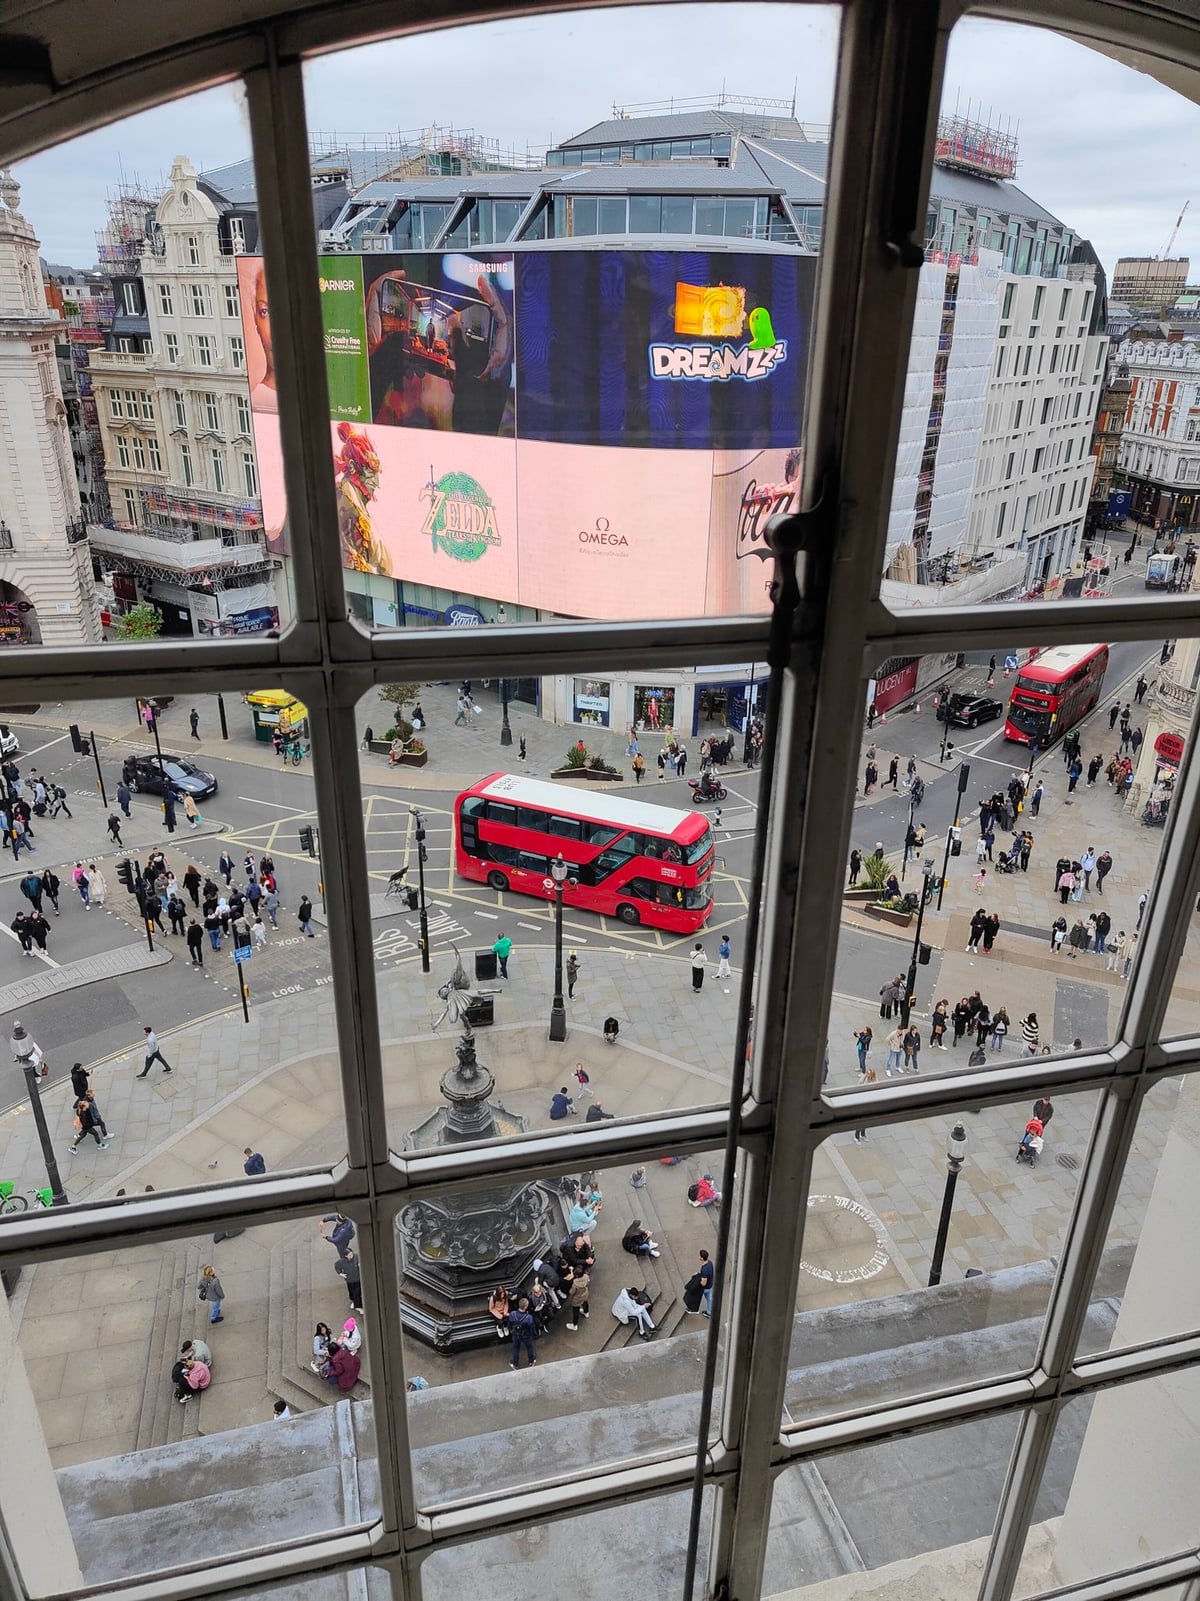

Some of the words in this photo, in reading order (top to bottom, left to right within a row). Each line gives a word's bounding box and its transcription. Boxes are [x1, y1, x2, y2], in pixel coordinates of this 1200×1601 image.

[468, 263, 508, 273] SAMSUNG
[419, 488, 500, 538] ZELDA
[579, 531, 629, 546] OMEGA
[876, 669, 906, 697] LUCENT
[272, 984, 305, 999] LOOK
[315, 975, 334, 987] RIG
